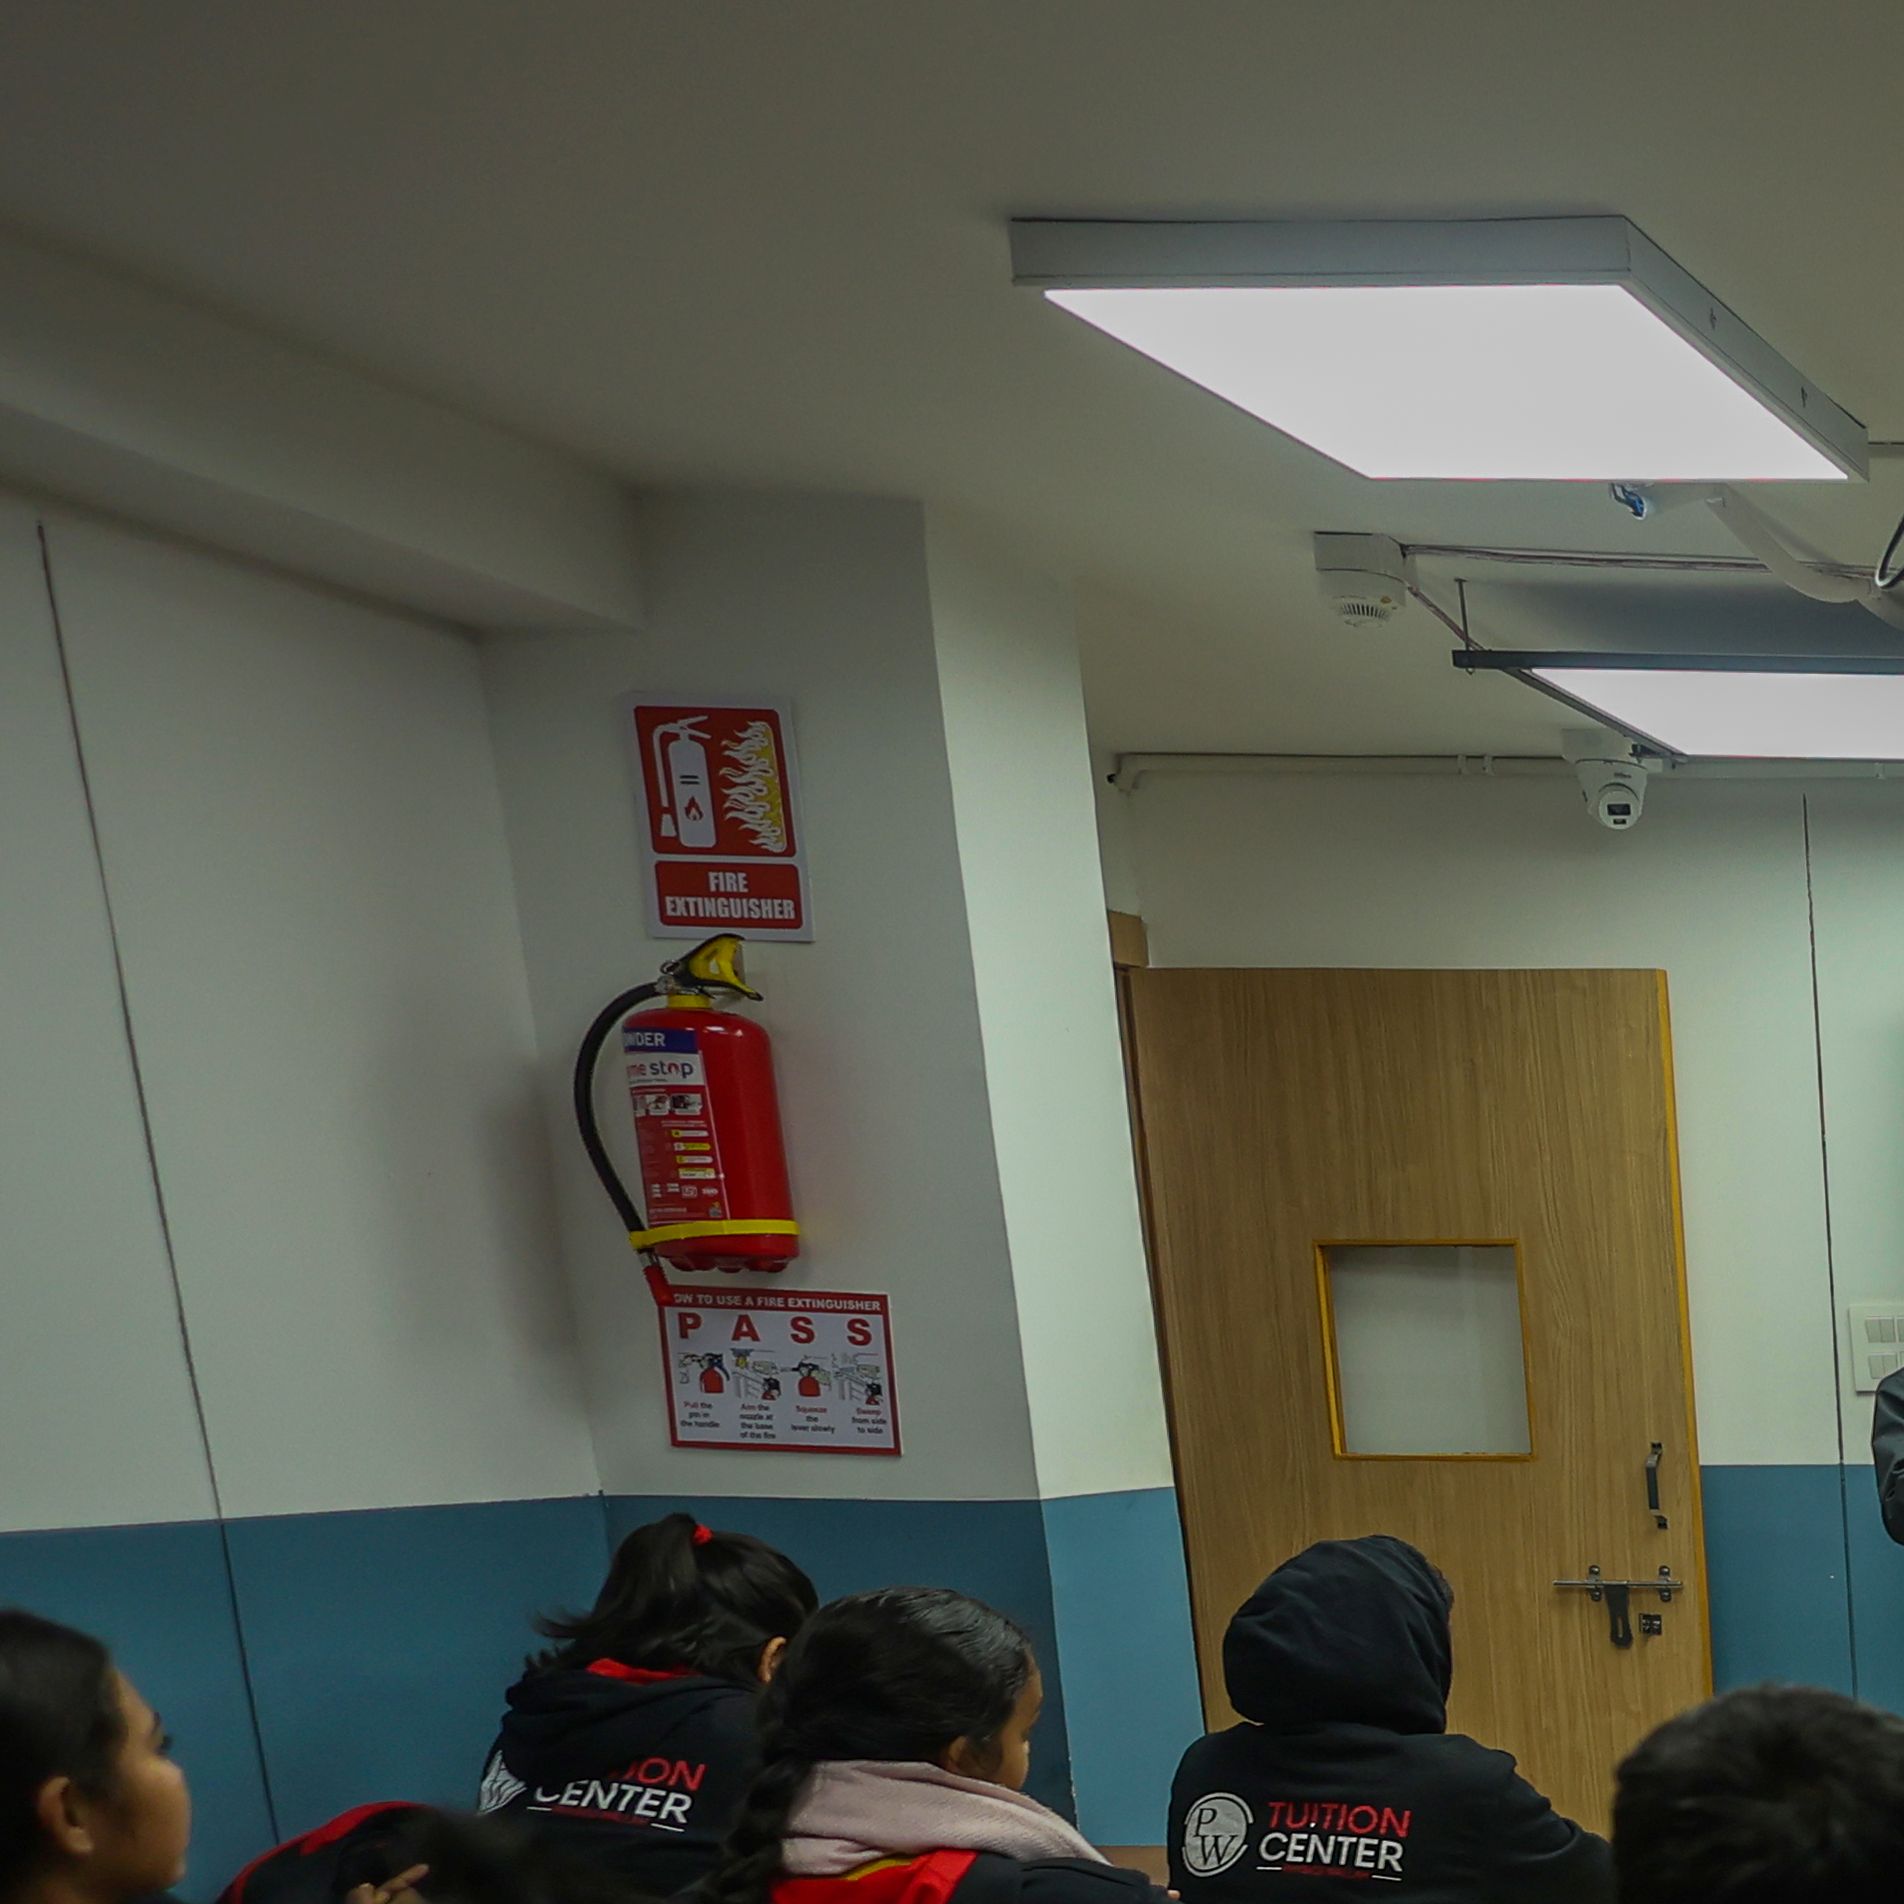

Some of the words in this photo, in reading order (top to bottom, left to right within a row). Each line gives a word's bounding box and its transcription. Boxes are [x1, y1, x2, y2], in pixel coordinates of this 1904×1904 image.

[708, 871, 749, 893] FIRE
[664, 895, 797, 920] EXTINGUISHER
[649, 1061, 693, 1079] stop
[673, 1293, 693, 1304] OW
[697, 1294, 713, 1305] TO
[717, 1296, 741, 1307] USE
[745, 1297, 754, 1307] A
[757, 1296, 785, 1308] FIRE
[787, 1297, 882, 1313] EXTINGUISHER
[678, 1312, 702, 1340] P
[731, 1314, 760, 1342] A
[790, 1316, 815, 1344] S
[847, 1318, 872, 1346] S
[1267, 1800, 1413, 1838] TUITION
[1259, 1830, 1404, 1873] CENTER
